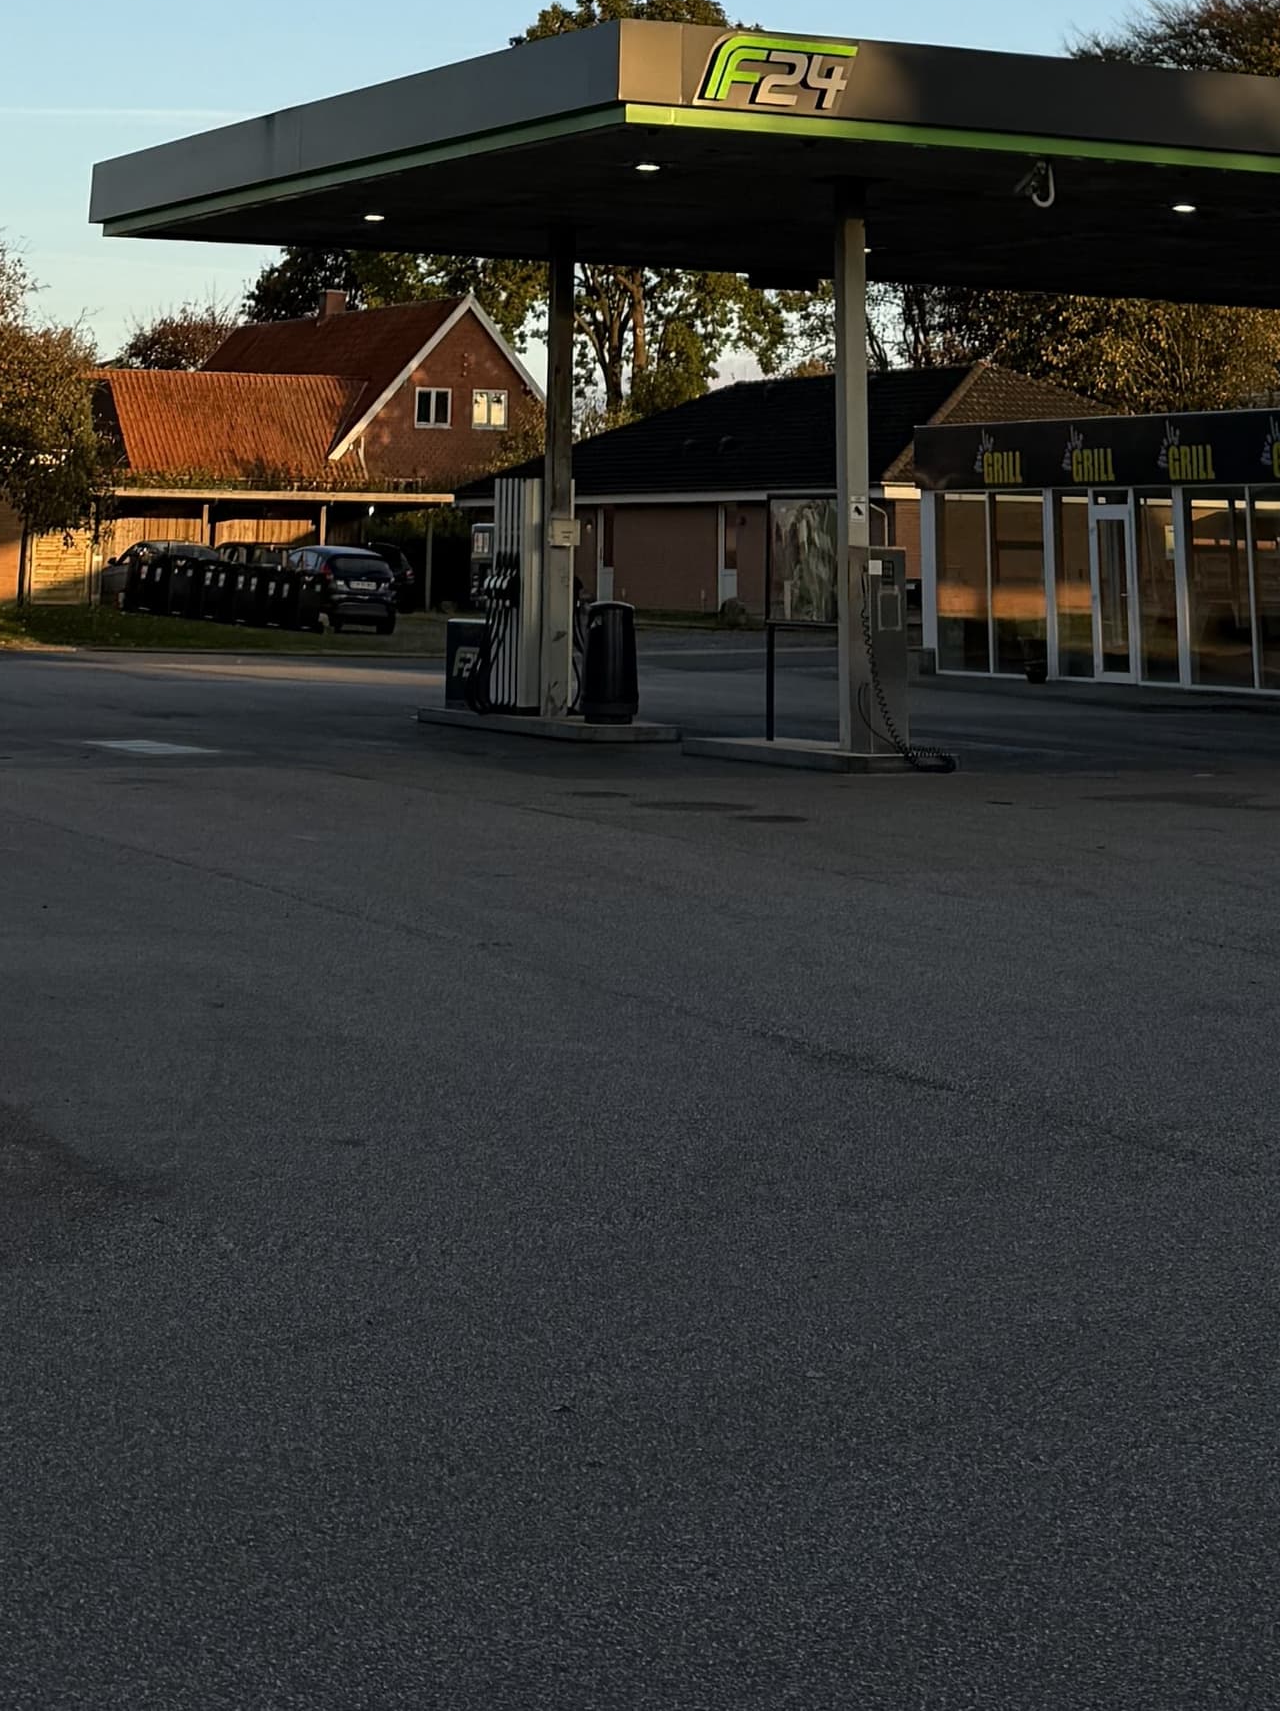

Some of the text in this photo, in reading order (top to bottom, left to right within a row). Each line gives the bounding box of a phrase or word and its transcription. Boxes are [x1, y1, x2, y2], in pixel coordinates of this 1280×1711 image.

[705, 35, 859, 110] F24
[983, 450, 1024, 485] GRILL
[1071, 447, 1116, 483] GRILL
[1167, 443, 1216, 481] GRILL
